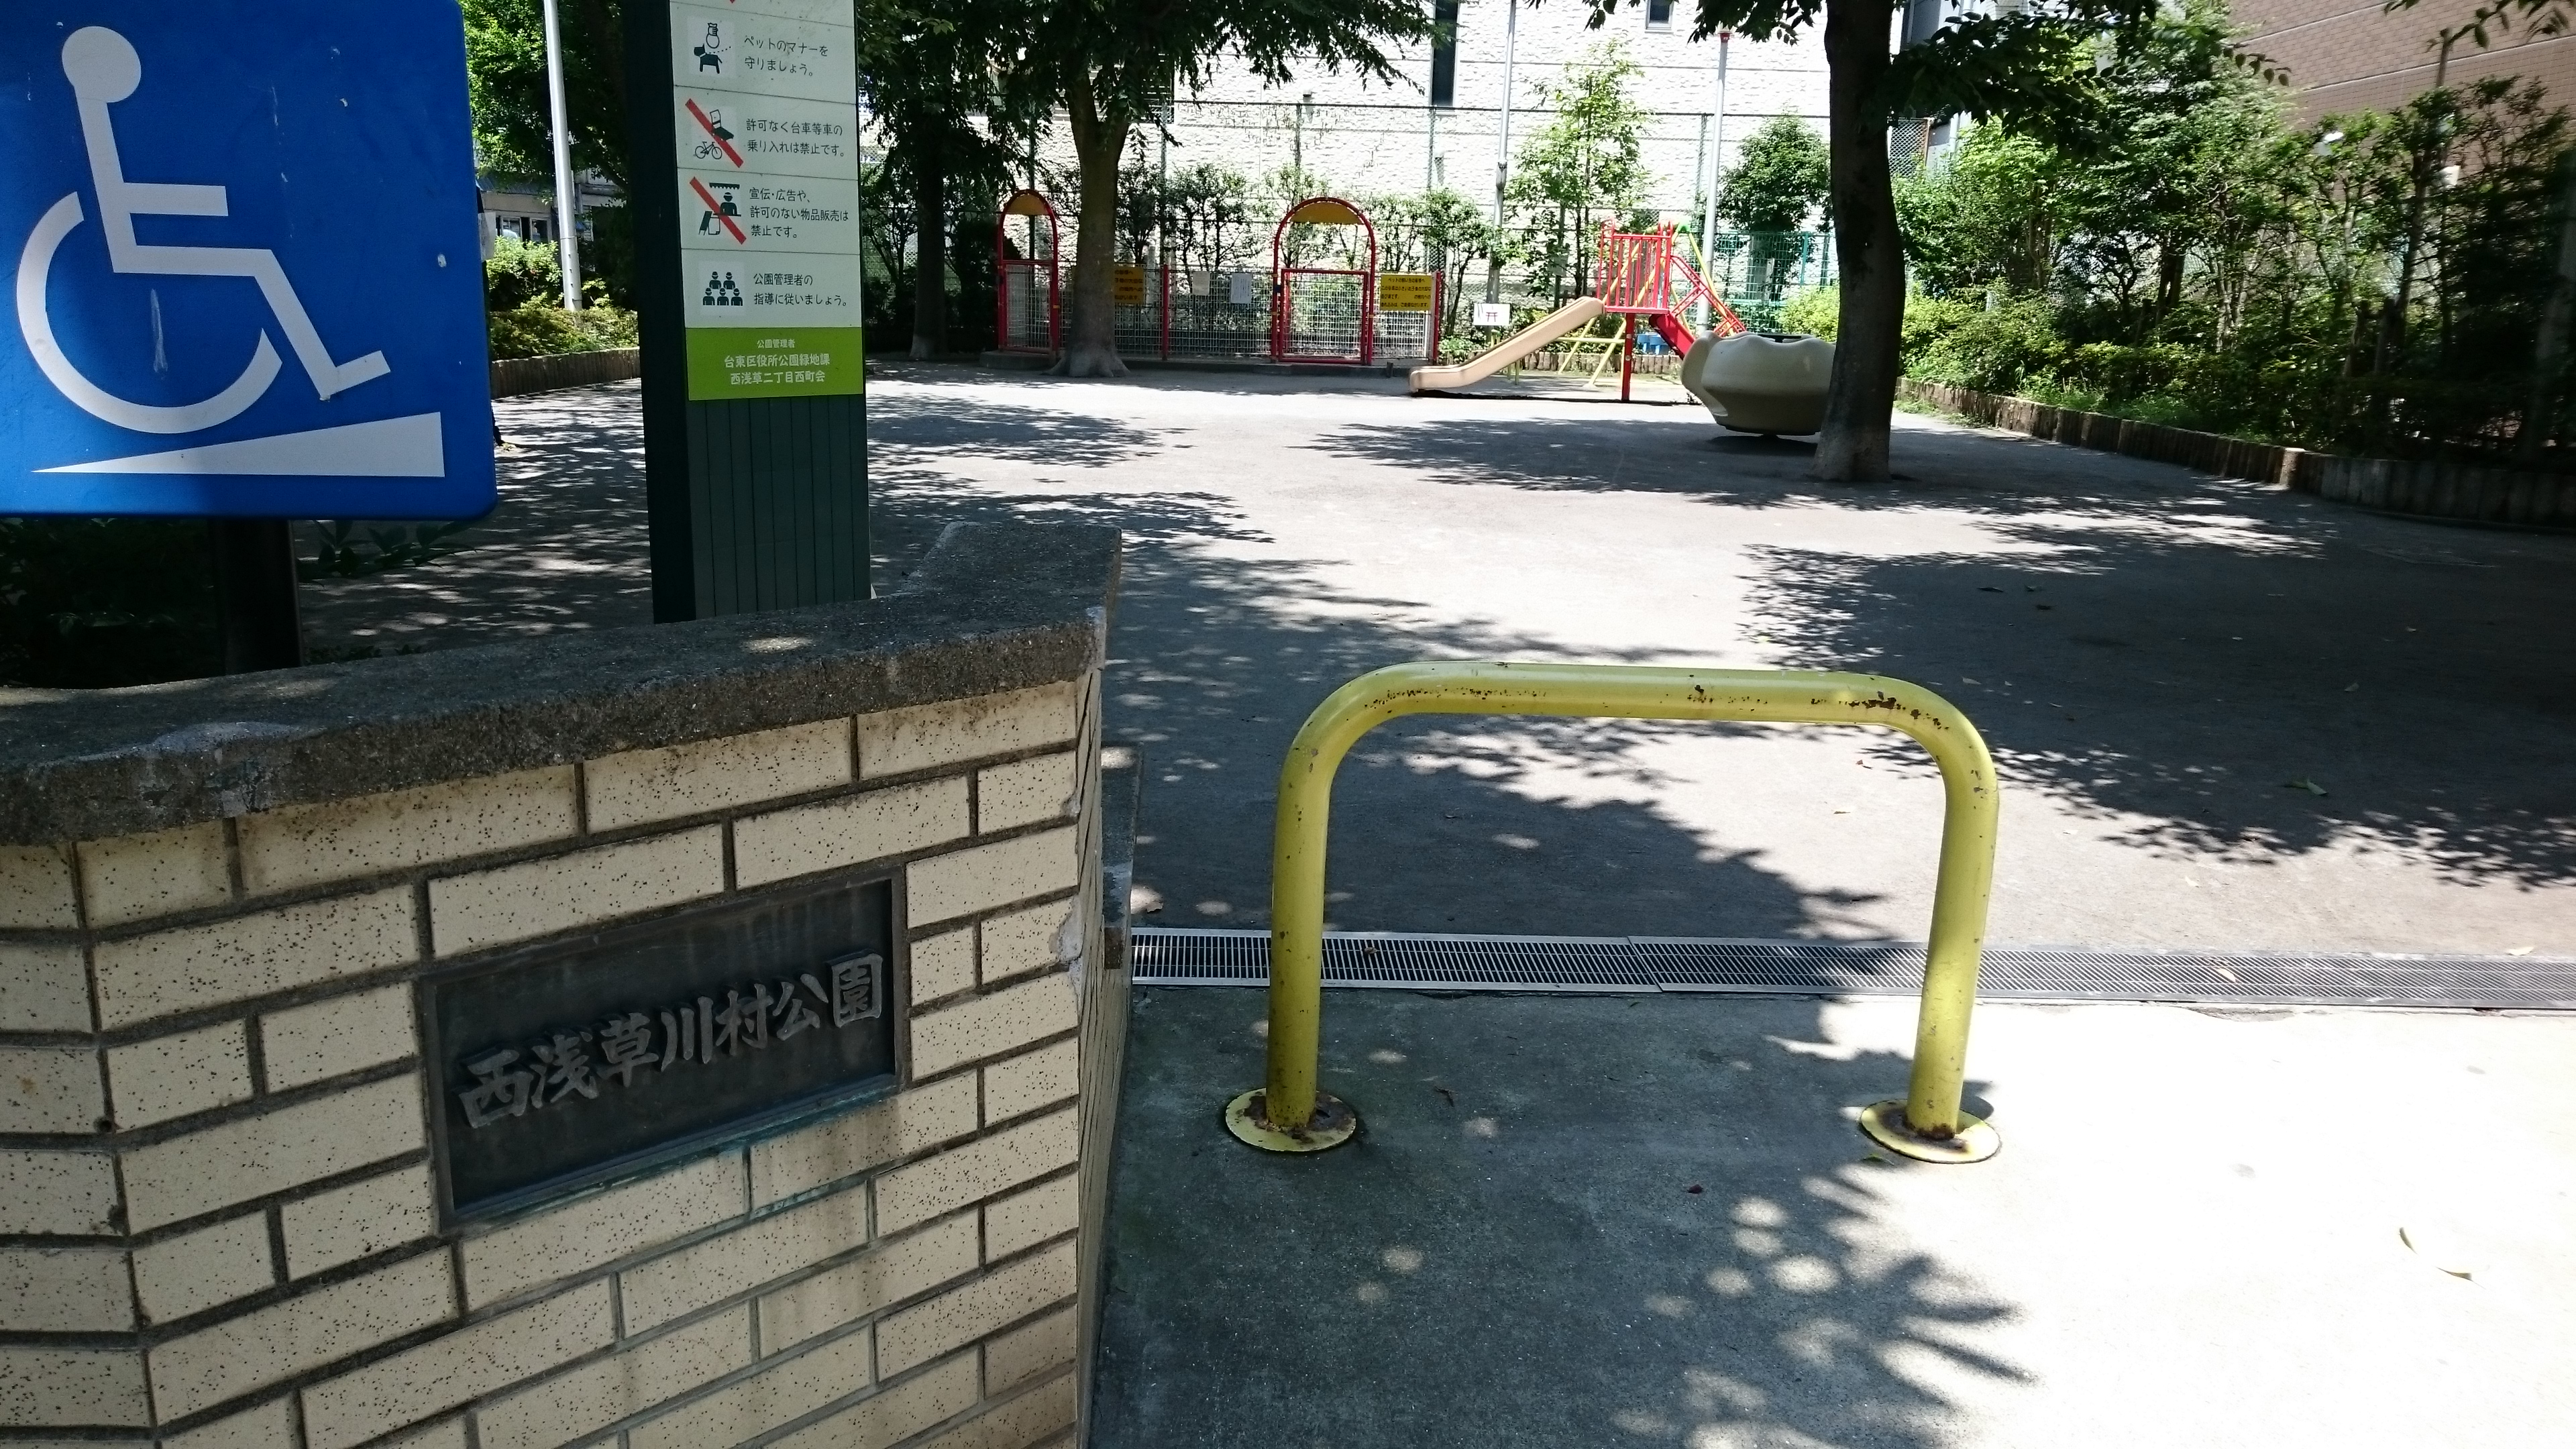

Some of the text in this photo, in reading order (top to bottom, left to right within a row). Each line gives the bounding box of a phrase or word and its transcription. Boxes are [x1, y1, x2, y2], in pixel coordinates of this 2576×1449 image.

[744, 36, 828, 57] ペットのマナーを
[745, 56, 813, 76] 守りましょう。
[746, 119, 843, 136] 許可なく台車等車の
[747, 140, 844, 157] 乗り入れは禁止です。
[750, 206, 849, 221] 許可のない物品販売は
[751, 225, 797, 239] 禁止です。
[753, 272, 813, 286] 公園管理者の
[753, 292, 847, 307] 指導に従いましょう。
[757, 339, 796, 349] 公園管理者
[724, 353, 830, 368] 台東区役所公園緑地課
[731, 370, 826, 385] 西浅草二丁目西町会
[459, 951, 883, 1128] 西浅草川村公園
